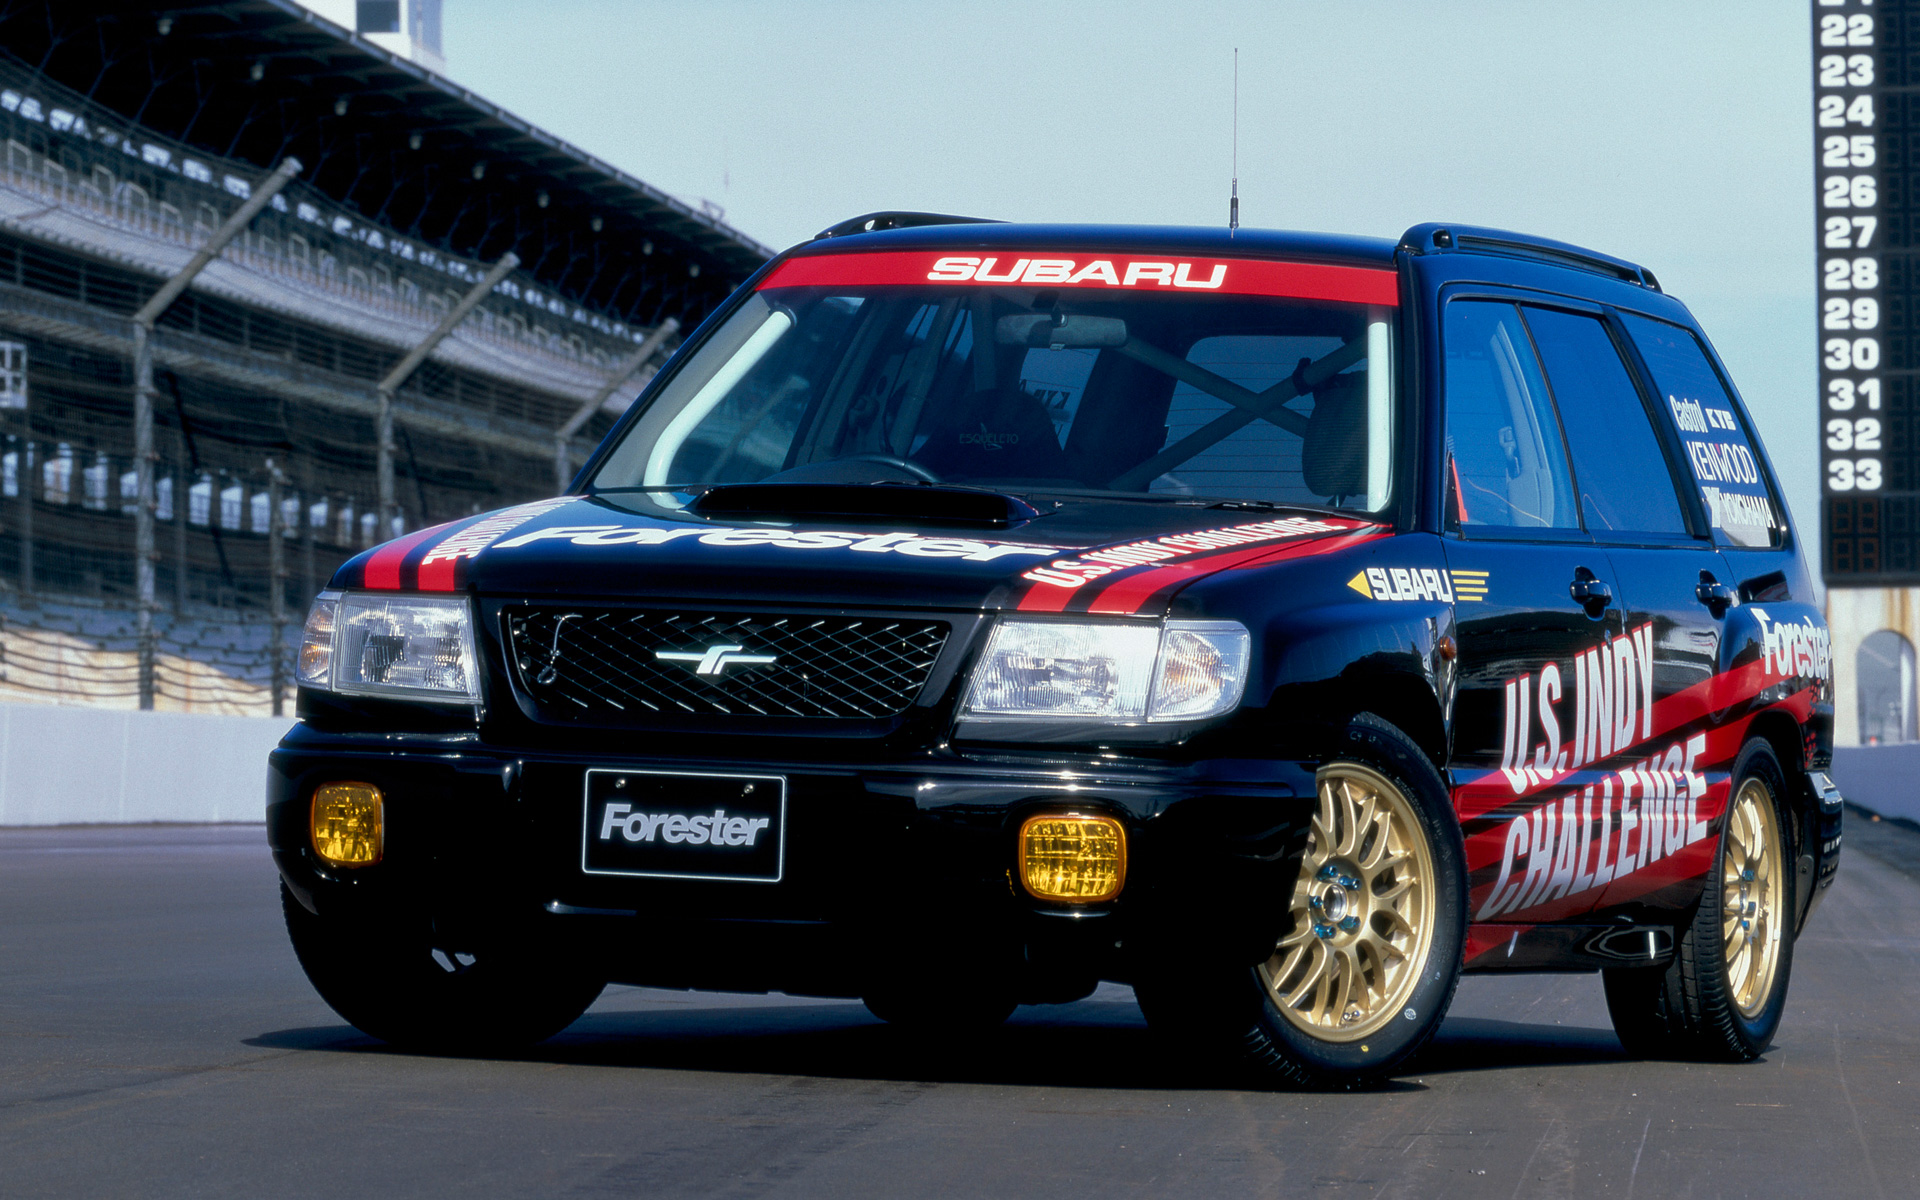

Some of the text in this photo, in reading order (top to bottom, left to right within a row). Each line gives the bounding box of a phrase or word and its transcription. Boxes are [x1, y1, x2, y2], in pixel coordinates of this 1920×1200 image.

[1821, 14, 1873, 46] 22
[1820, 55, 1874, 87] 23
[1819, 95, 1875, 127] 24
[1823, 136, 1875, 167] 25
[1824, 175, 1876, 207] 26
[1825, 216, 1877, 248] 27
[927, 257, 1227, 288] SUBARU
[1825, 258, 1878, 290] 28
[1824, 298, 1878, 329] 29
[1824, 338, 1880, 370] 30
[1828, 378, 1881, 411] 31
[1669, 395, 1736, 433] Castrol KYB
[1826, 418, 1881, 451] 32
[1687, 441, 1757, 484] KENWOOD
[1828, 458, 1882, 491] 33
[1719, 492, 1777, 529] YOKOHAMA
[492, 525, 1060, 562] Forester
[1021, 517, 1348, 588] U.S. INDY CHALLENGE
[1367, 568, 1454, 602] SUBARU
[1750, 608, 1830, 680] Forester
[1501, 623, 1653, 794] U.S. INDY
[601, 803, 769, 846] Forester
[1475, 734, 1707, 921] CHALLENGE
